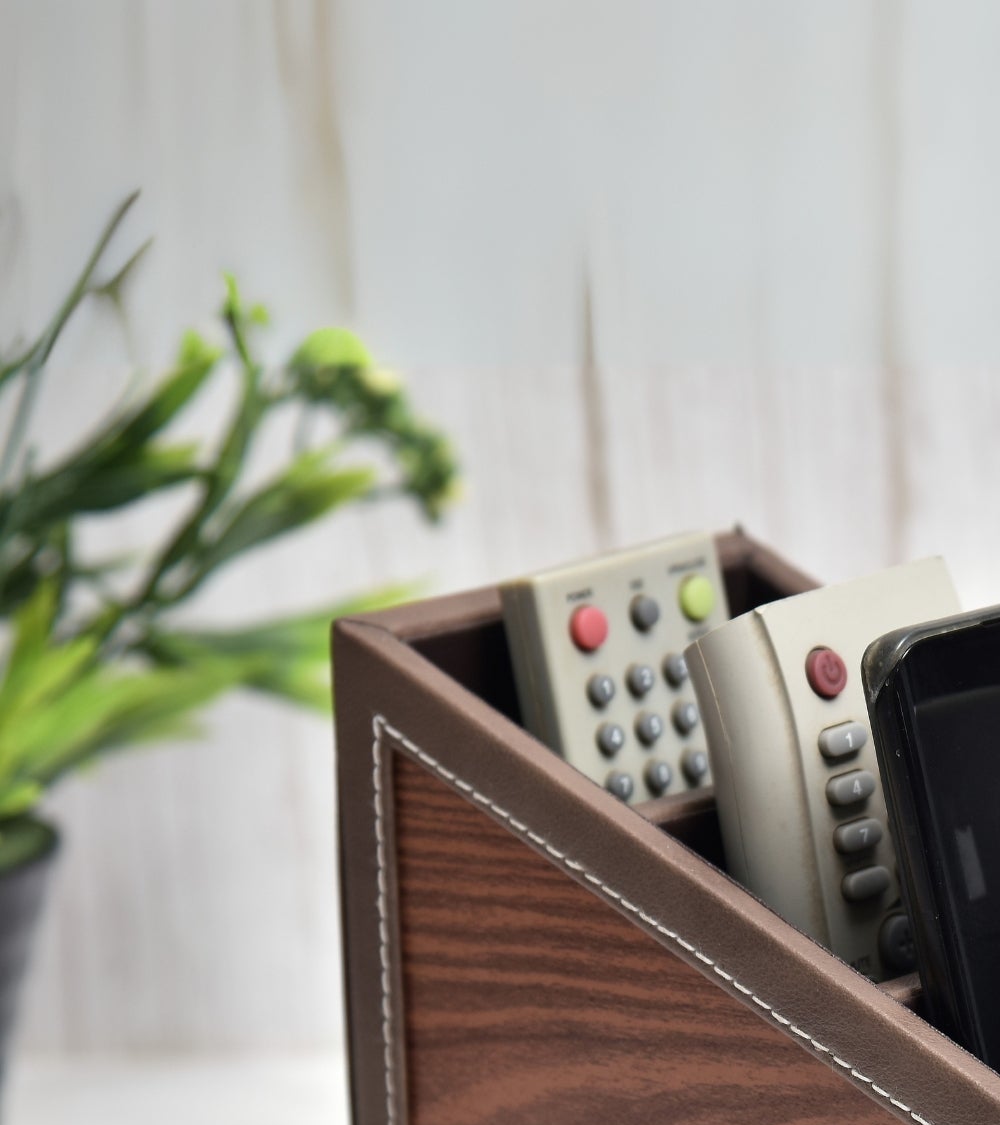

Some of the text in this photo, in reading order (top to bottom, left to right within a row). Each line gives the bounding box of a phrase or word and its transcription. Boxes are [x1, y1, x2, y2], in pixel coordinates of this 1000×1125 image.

[603, 678, 612, 695] 1
[611, 727, 622, 746] 4
[845, 732, 854, 748] 1
[852, 779, 862, 796] 4
[859, 828, 869, 843] 7
